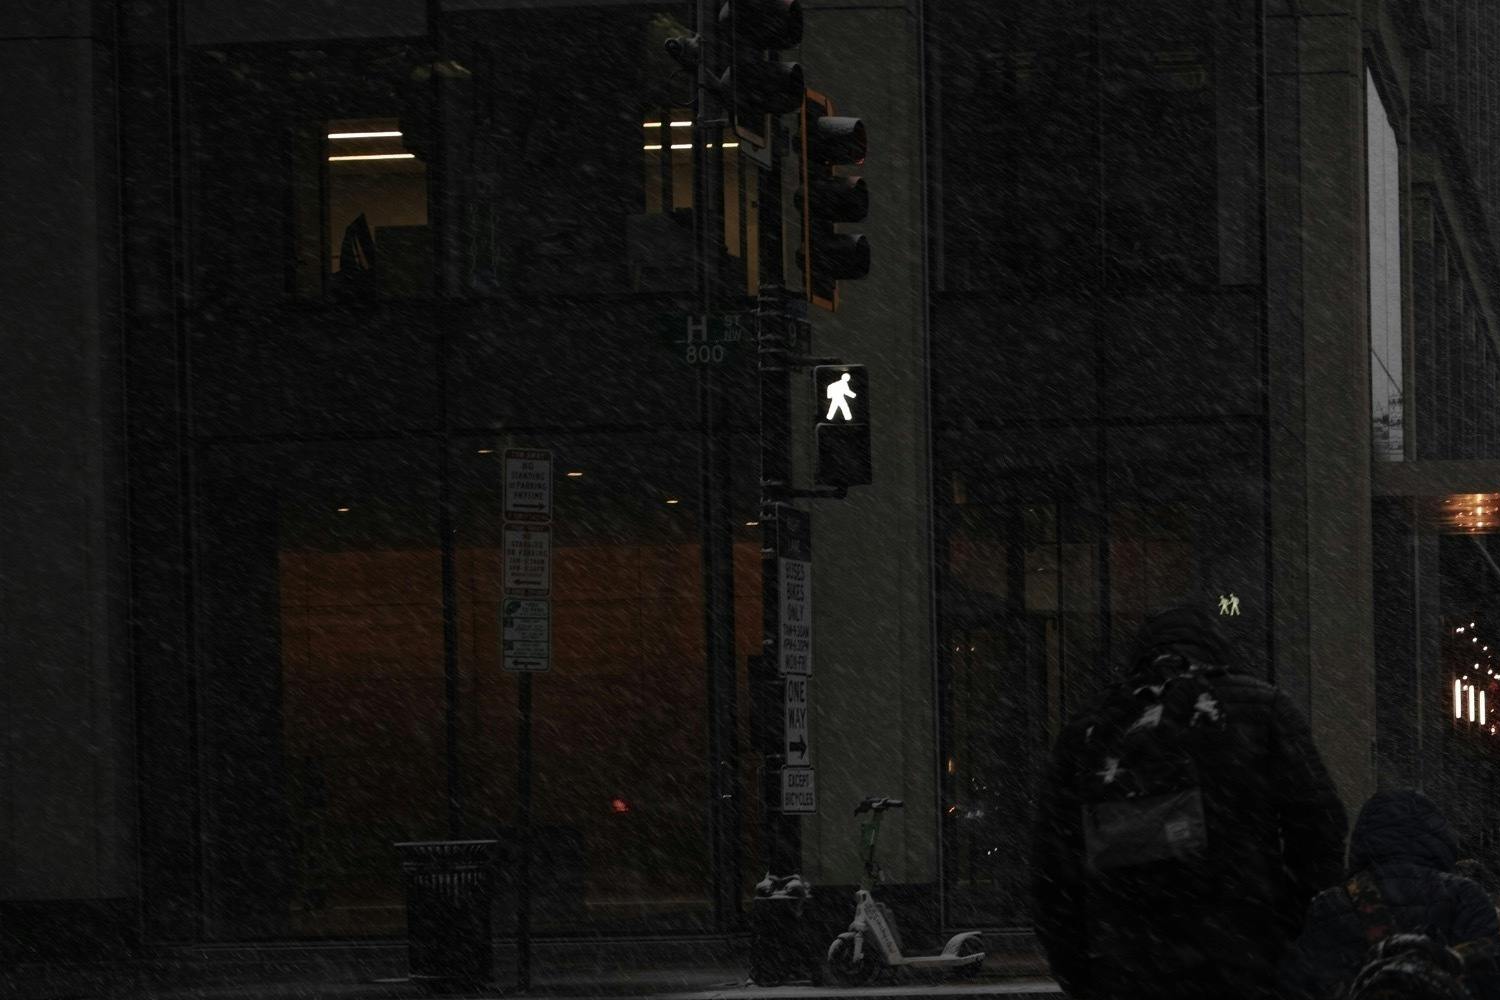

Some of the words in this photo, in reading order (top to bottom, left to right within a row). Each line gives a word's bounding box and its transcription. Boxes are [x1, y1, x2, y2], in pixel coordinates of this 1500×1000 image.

[687, 315, 707, 342] H
[686, 345, 724, 364] 800
[786, 582, 805, 602] BIKES
[787, 603, 805, 622] ONLY
[788, 680, 805, 703] ONE
[788, 708, 806, 729] WAY
[788, 774, 809, 787] EXCEPT
[785, 792, 813, 806] BICYCLES
